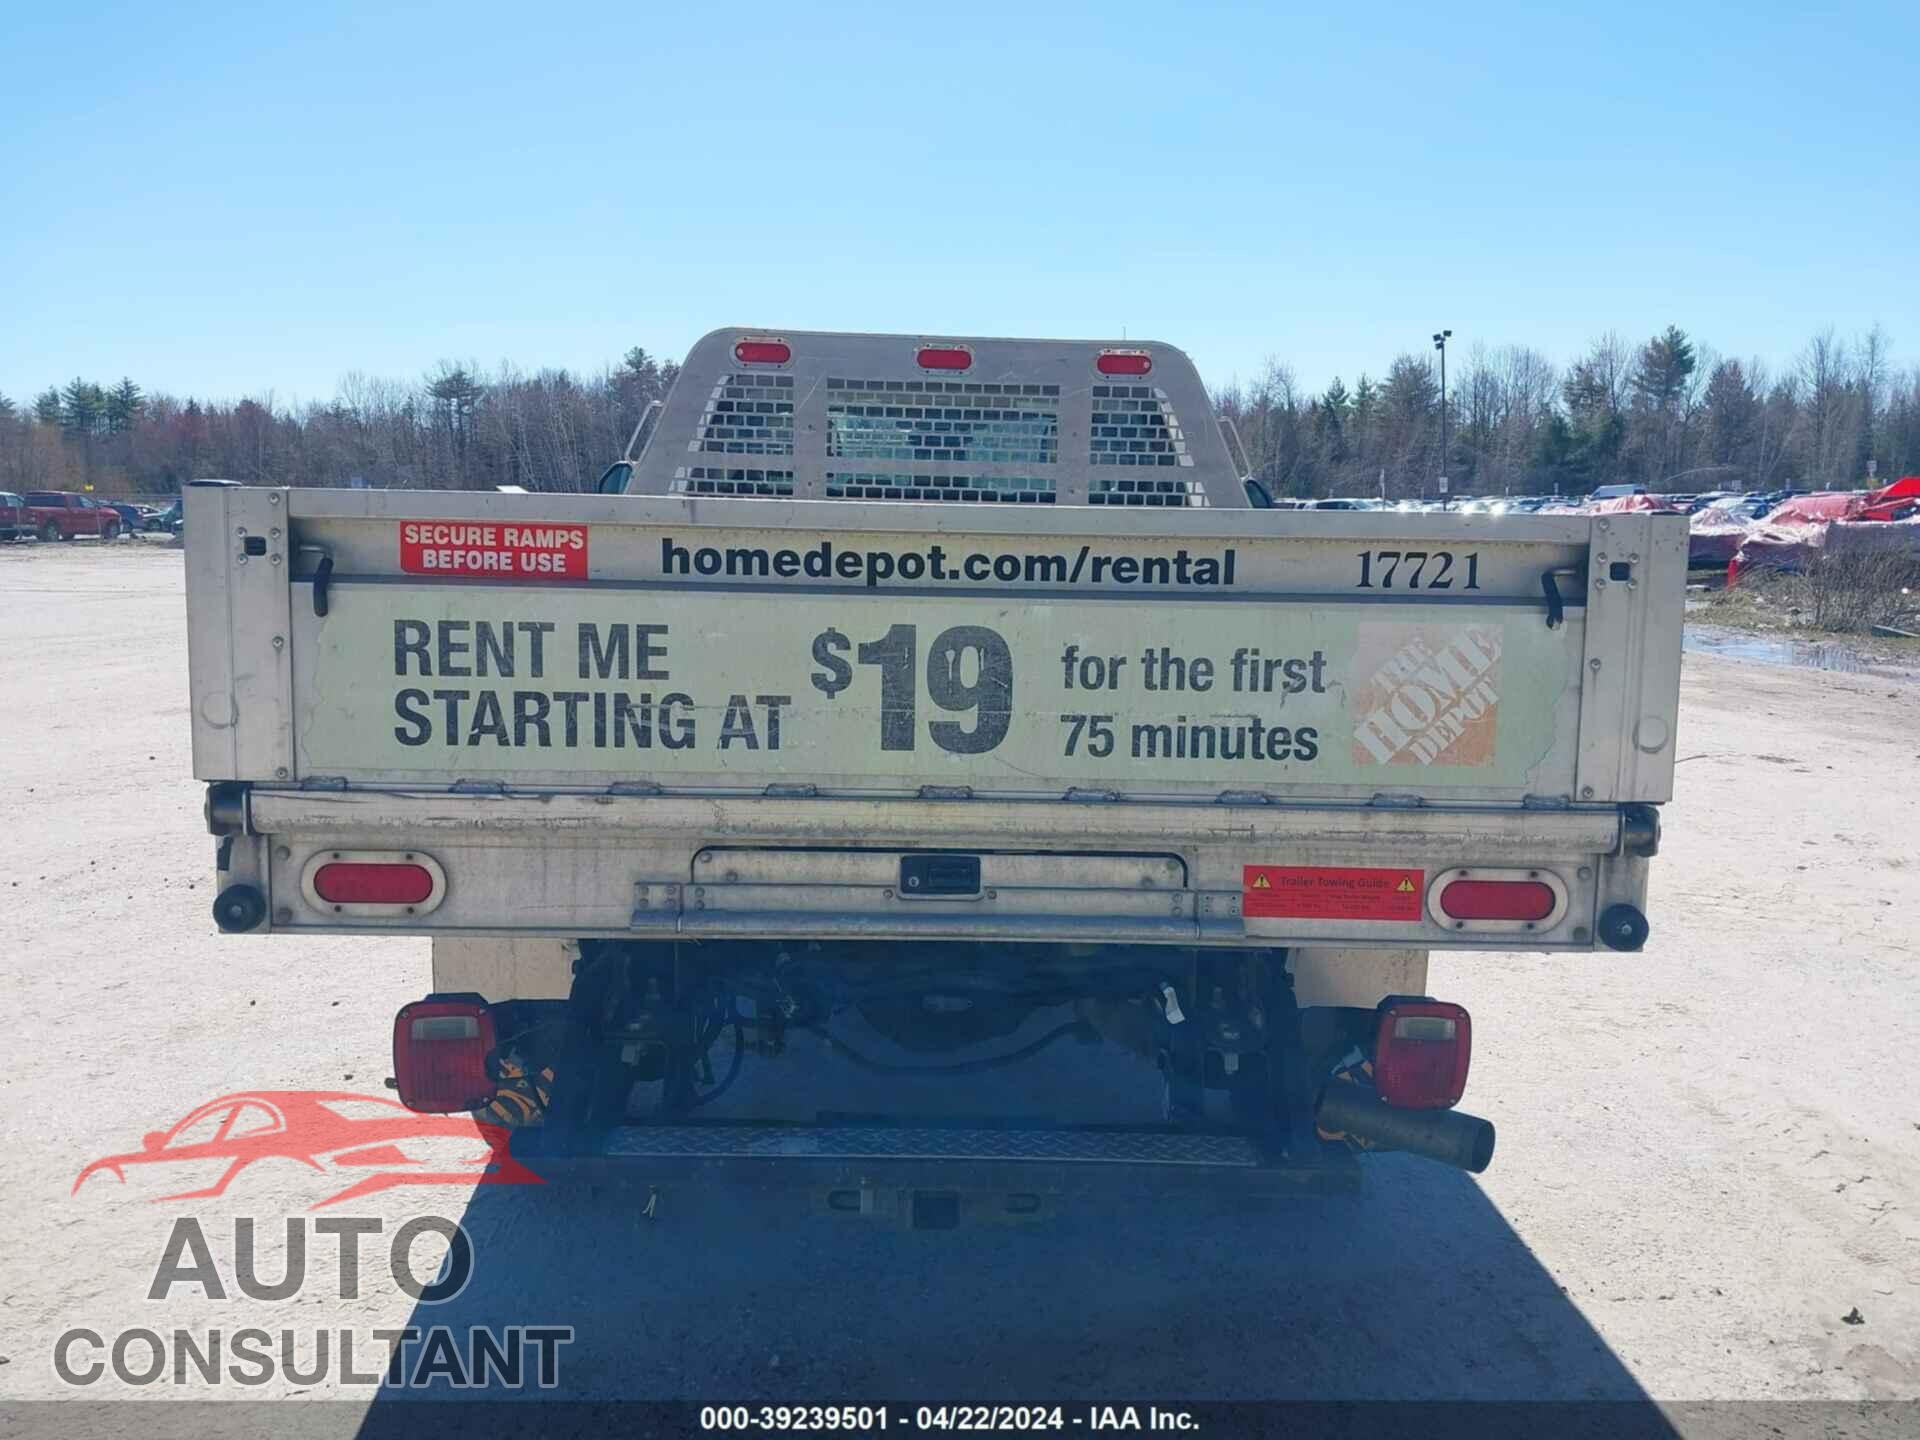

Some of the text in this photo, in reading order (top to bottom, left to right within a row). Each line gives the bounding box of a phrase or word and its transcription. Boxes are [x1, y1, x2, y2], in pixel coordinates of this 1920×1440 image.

[403, 523, 584, 550] SECURE RAMPS
[421, 548, 568, 573] BEFORE USE
[661, 538, 1237, 588] homedepot.com/rental
[1355, 550, 1481, 590] 17721
[393, 619, 670, 681] RENT ME
[1060, 644, 1328, 696] for the first
[1371, 635, 1438, 693] THE
[810, 623, 1014, 755] $19
[1354, 625, 1502, 765] HOME
[393, 687, 792, 751] STARTING AT
[1059, 713, 1319, 762] 75 minutes
[1409, 677, 1499, 766] DEPOT
[1281, 876, 1391, 890] Trailer Towing Guide
